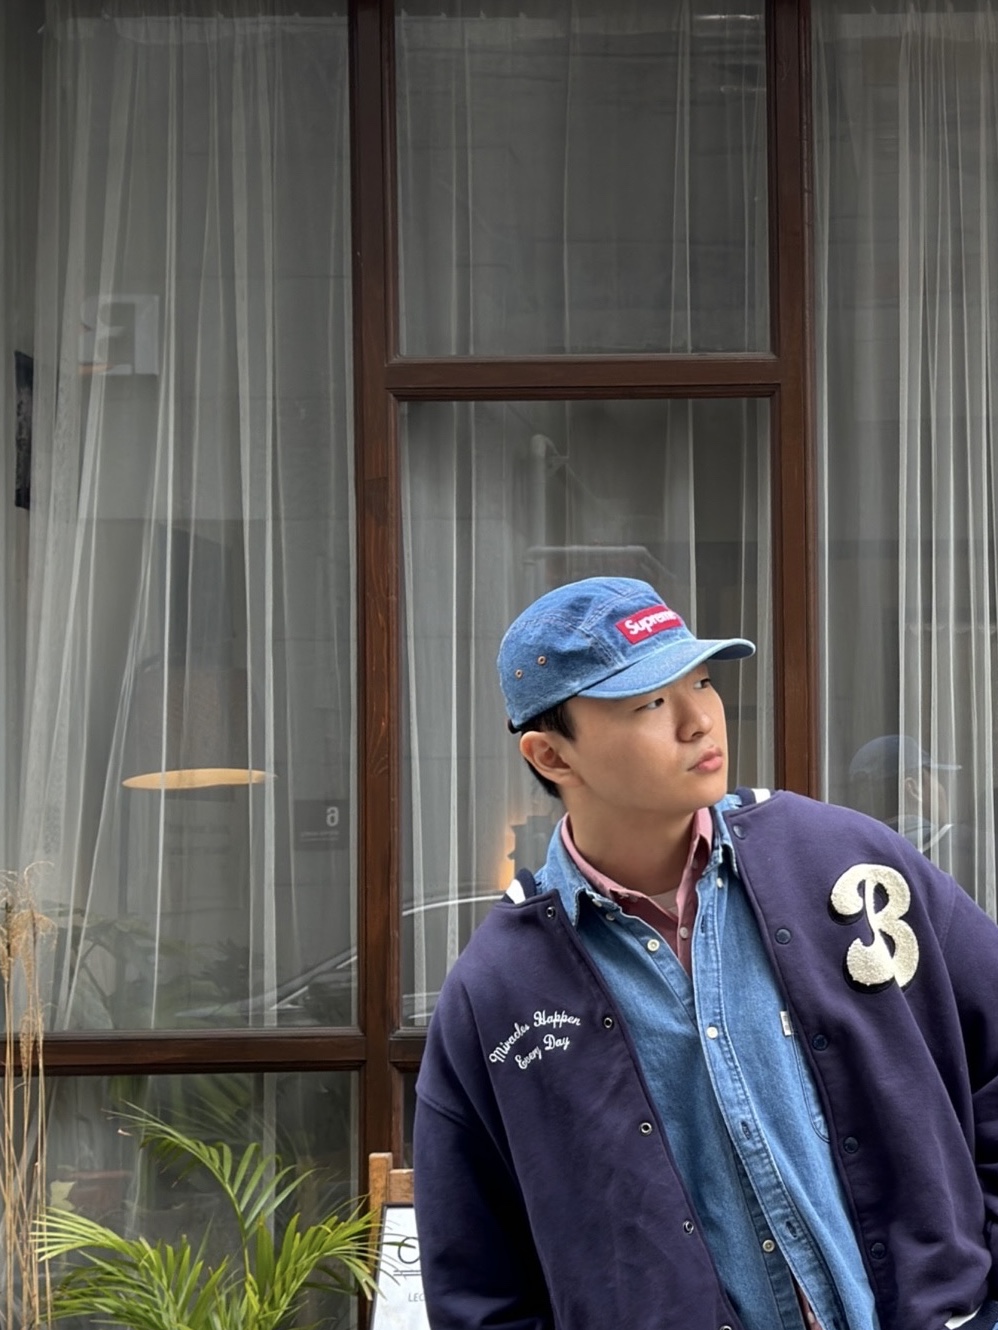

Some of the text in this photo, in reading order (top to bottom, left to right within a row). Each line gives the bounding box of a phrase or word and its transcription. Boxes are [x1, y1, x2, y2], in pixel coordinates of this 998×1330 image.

[830, 863, 919, 988] B
[488, 1010, 581, 1063] Miracles Happen
[515, 1034, 570, 1070] Every Day
